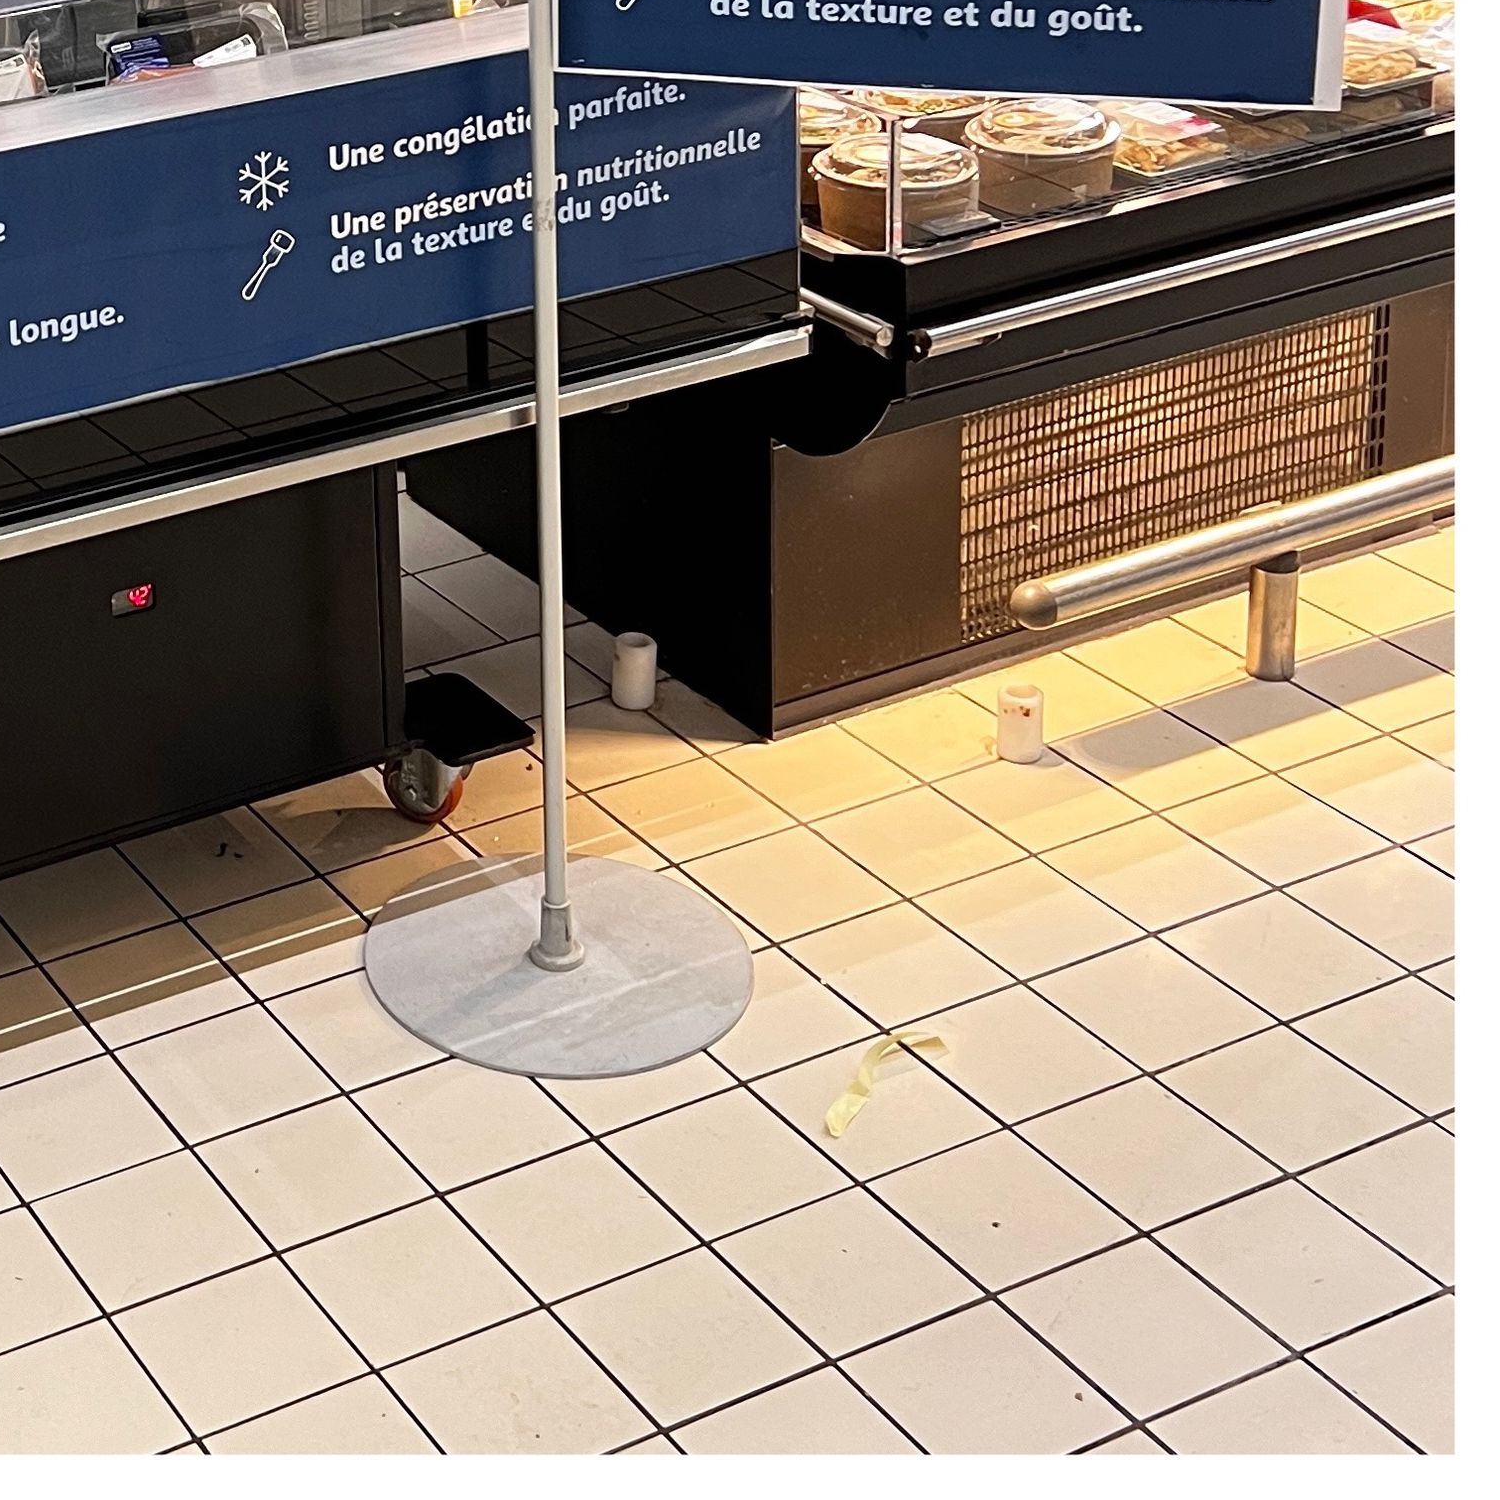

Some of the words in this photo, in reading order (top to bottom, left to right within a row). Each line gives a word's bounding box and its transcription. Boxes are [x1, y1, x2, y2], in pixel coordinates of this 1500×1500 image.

[944, 3, 979, 26] et
[991, 1, 1035, 27] du
[1048, 4, 1142, 36] goût.
[330, 144, 384, 170] Une
[569, 81, 685, 129] parfaite.
[331, 212, 385, 238] Une
[395, 172, 568, 232] préservatin
[578, 129, 760, 188] nutritionnelle
[332, 246, 365, 273] de
[375, 238, 402, 263] la
[412, 218, 513, 255] texture
[558, 197, 590, 223] du
[601, 181, 669, 221] goût.
[10, 307, 124, 345] longue.
